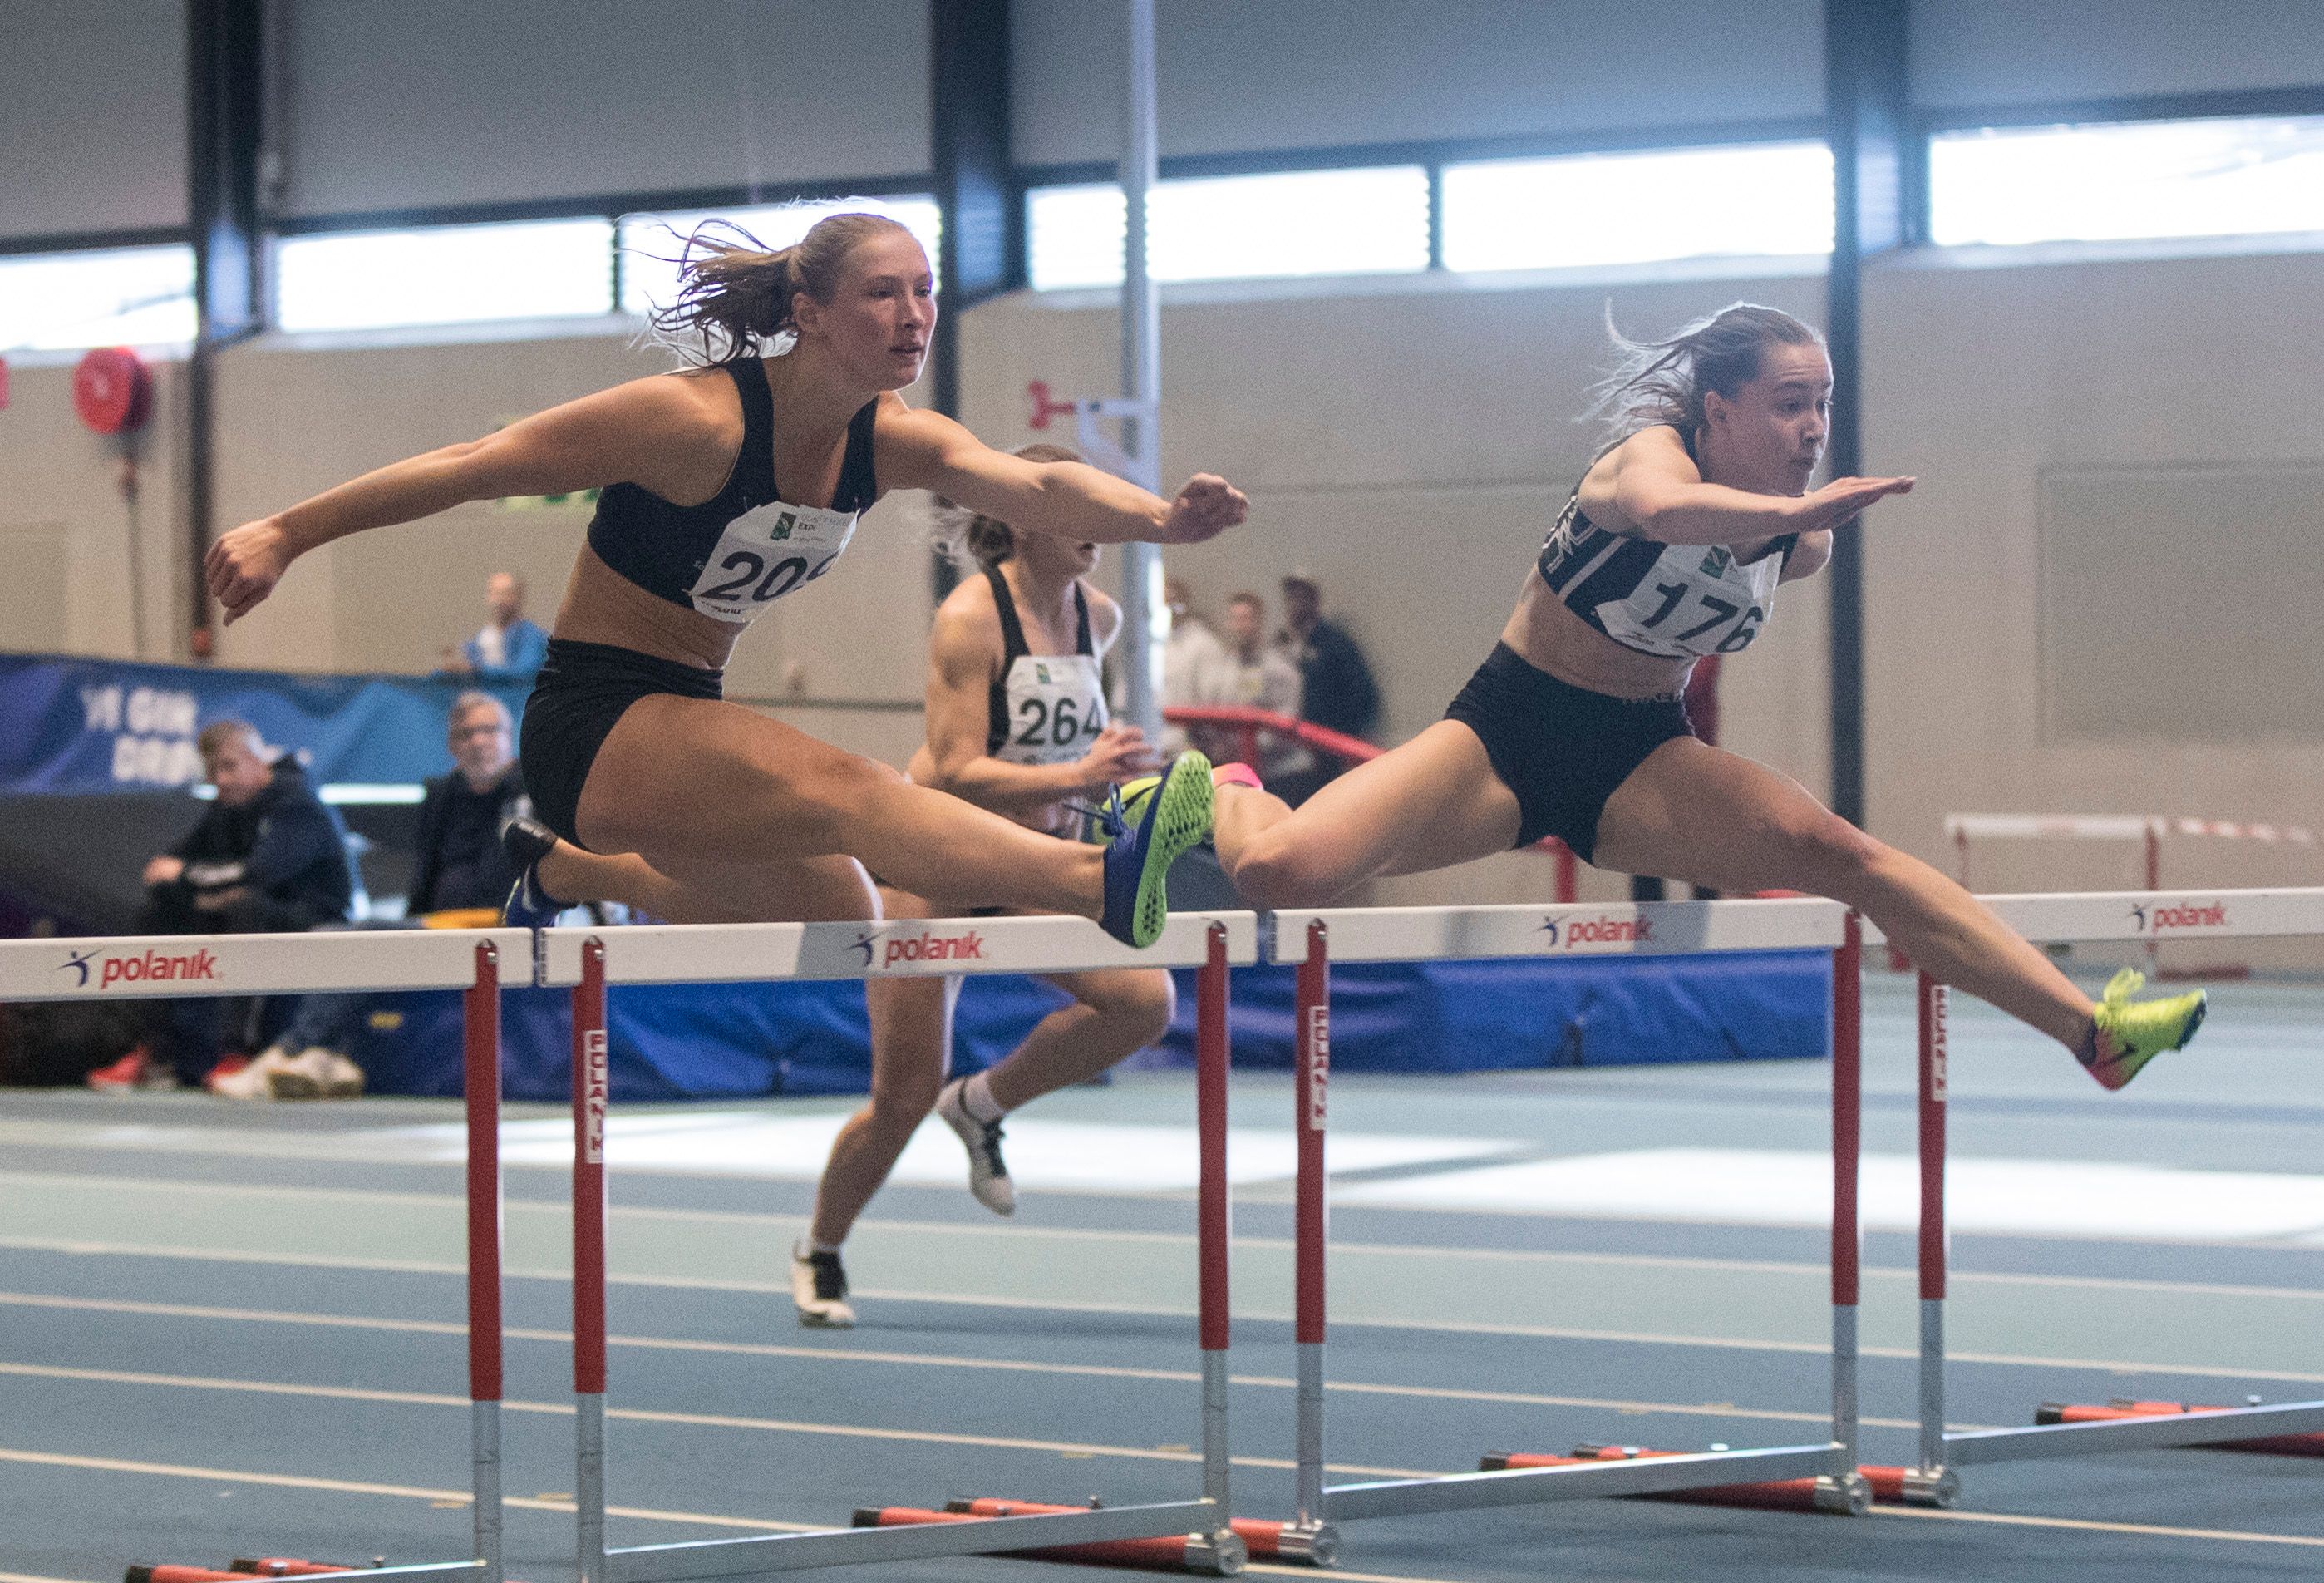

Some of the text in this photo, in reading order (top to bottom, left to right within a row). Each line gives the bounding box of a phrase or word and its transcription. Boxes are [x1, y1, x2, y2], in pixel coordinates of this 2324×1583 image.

[1642, 582, 1764, 653] 176
[1016, 697, 1104, 746] 264
[1564, 914, 1655, 949] polanik
[2150, 900, 2226, 935] polanik
[101, 948, 217, 989] polanik
[884, 930, 986, 969] polanik
